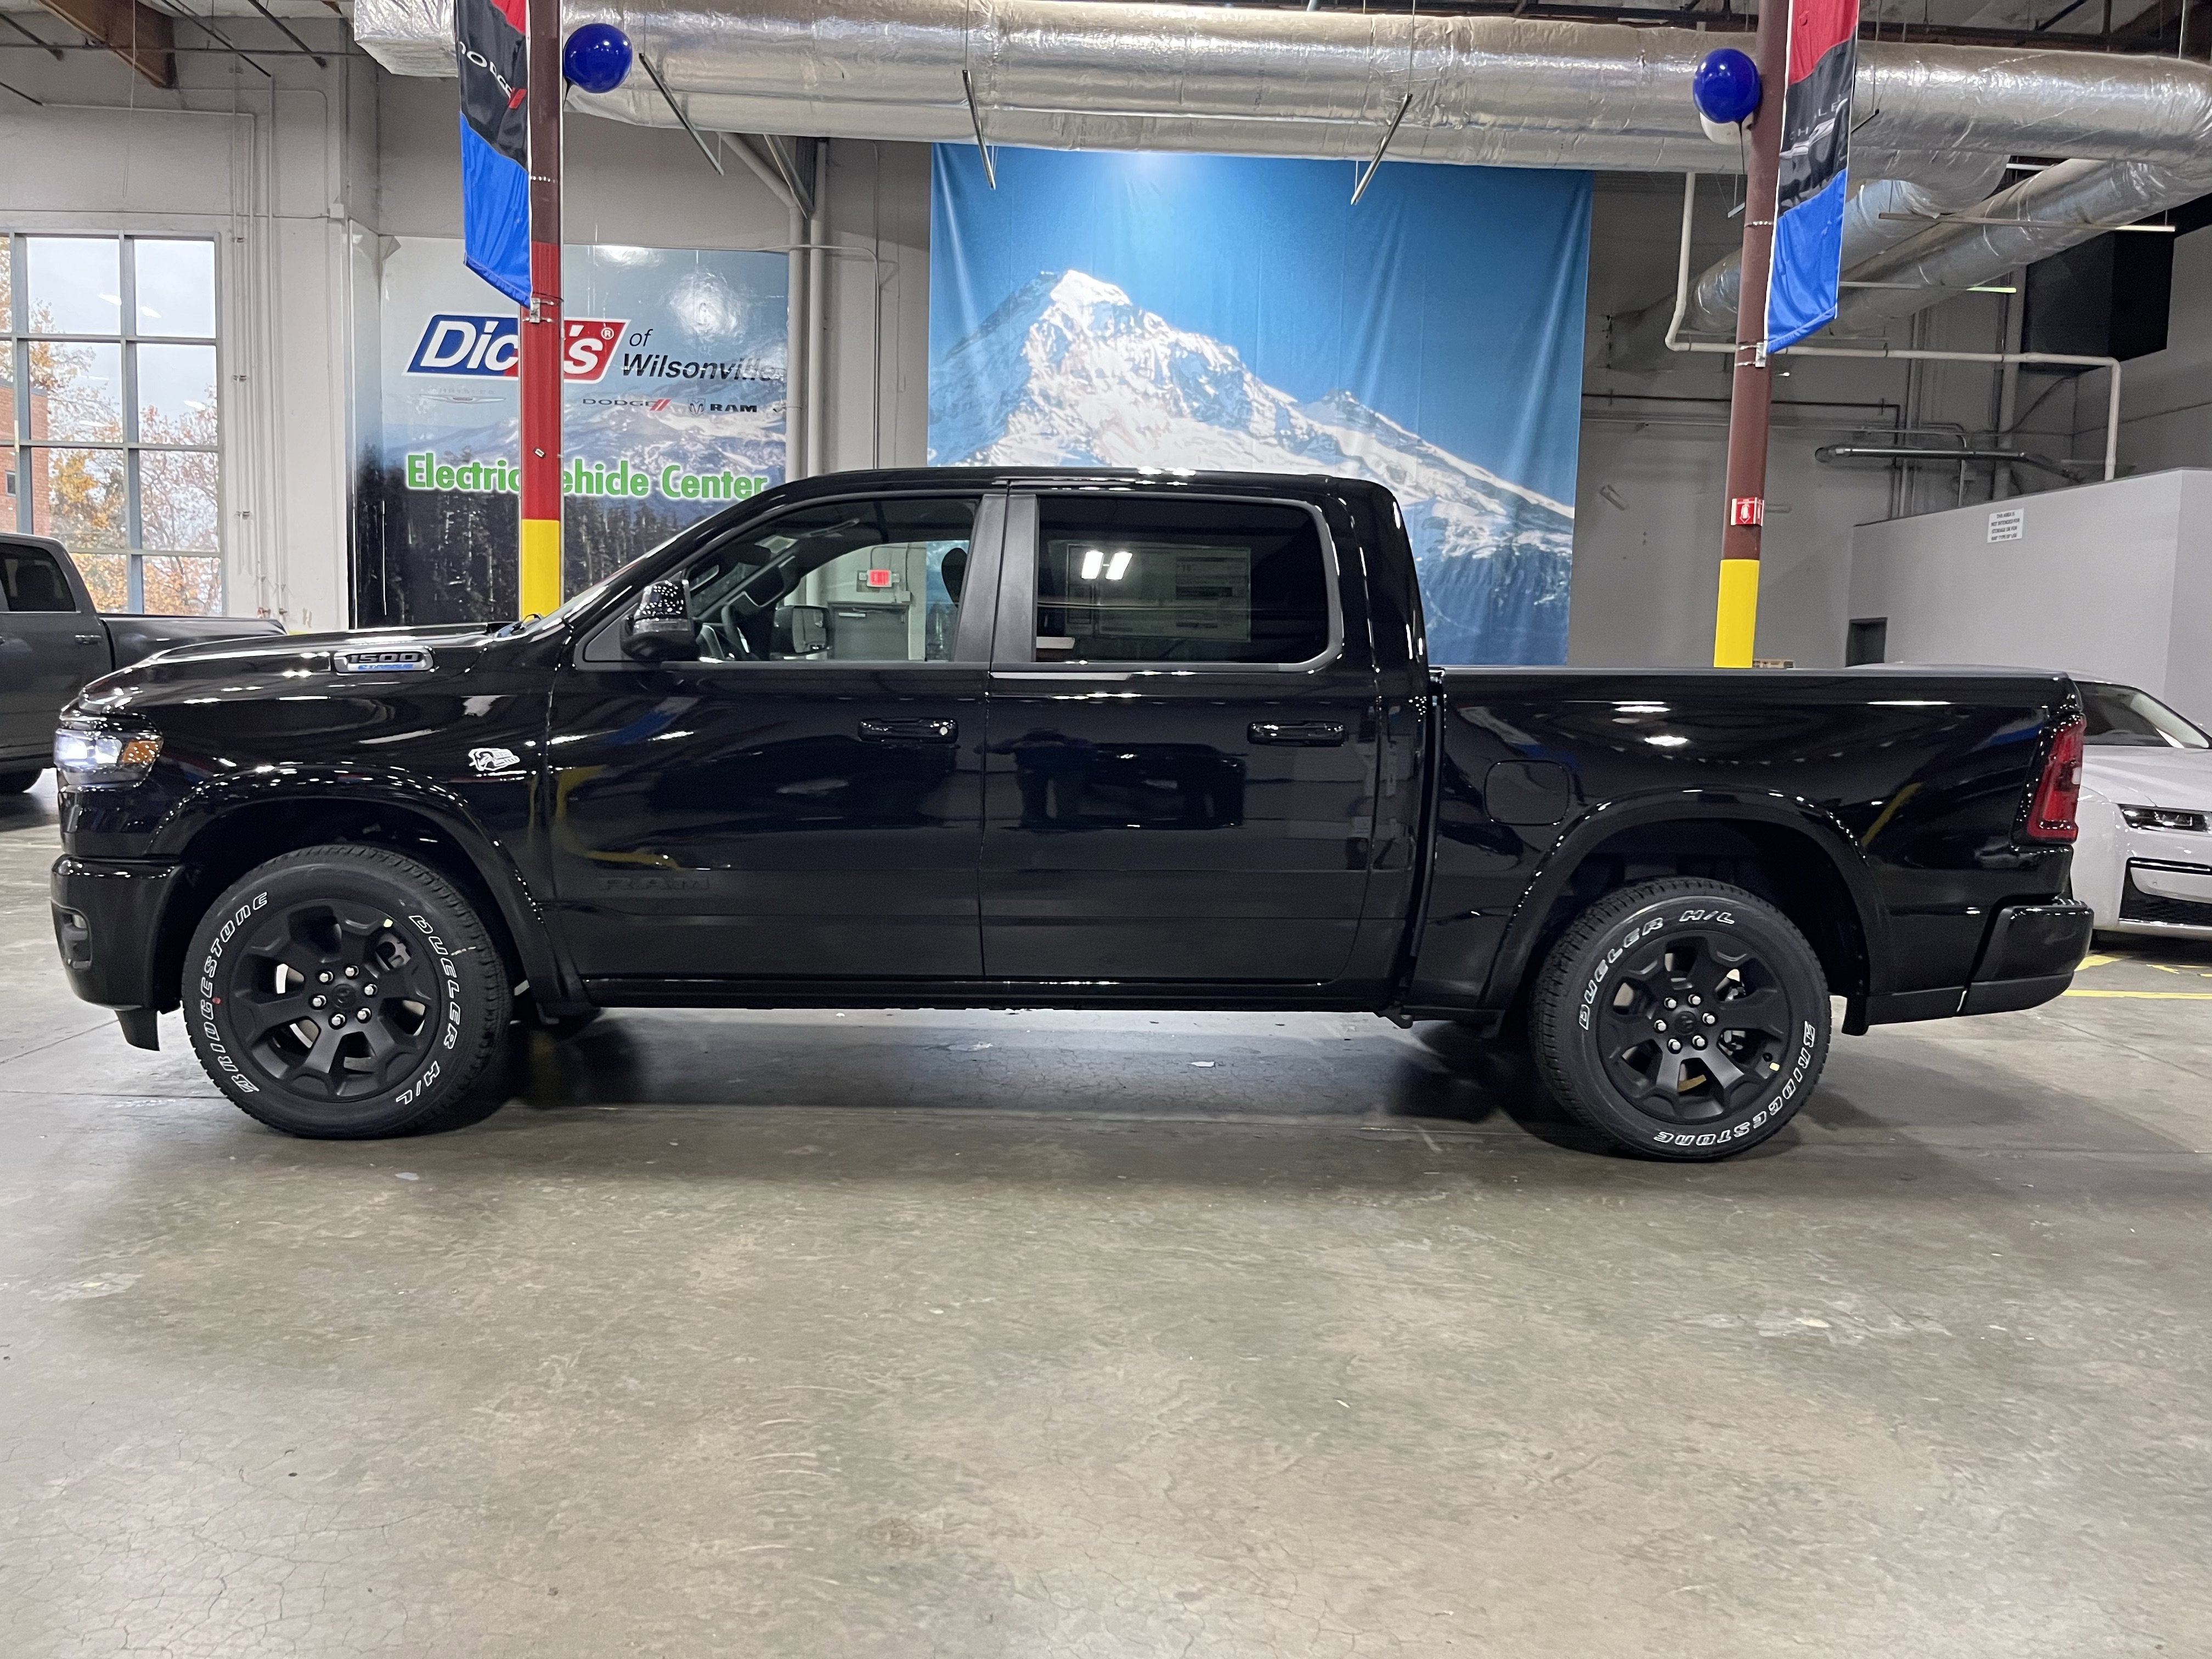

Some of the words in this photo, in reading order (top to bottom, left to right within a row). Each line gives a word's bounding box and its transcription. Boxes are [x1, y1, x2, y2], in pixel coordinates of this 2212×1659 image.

[420, 320, 603, 374] Dic's
[629, 329, 653, 347] of
[583, 398, 657, 407] DODGE
[710, 403, 758, 413] RAM
[408, 453, 520, 492] Electric
[563, 458, 649, 496] ehicle
[662, 465, 768, 499] Center
[347, 653, 419, 663] 1500
[599, 877, 710, 890] RAM
[201, 891, 268, 1093] BRIDGESTONE
[409, 915, 461, 1049] DUELER
[1579, 917, 1663, 1030] DUELER
[1654, 1020, 1815, 1146] BRIDGESTONE
